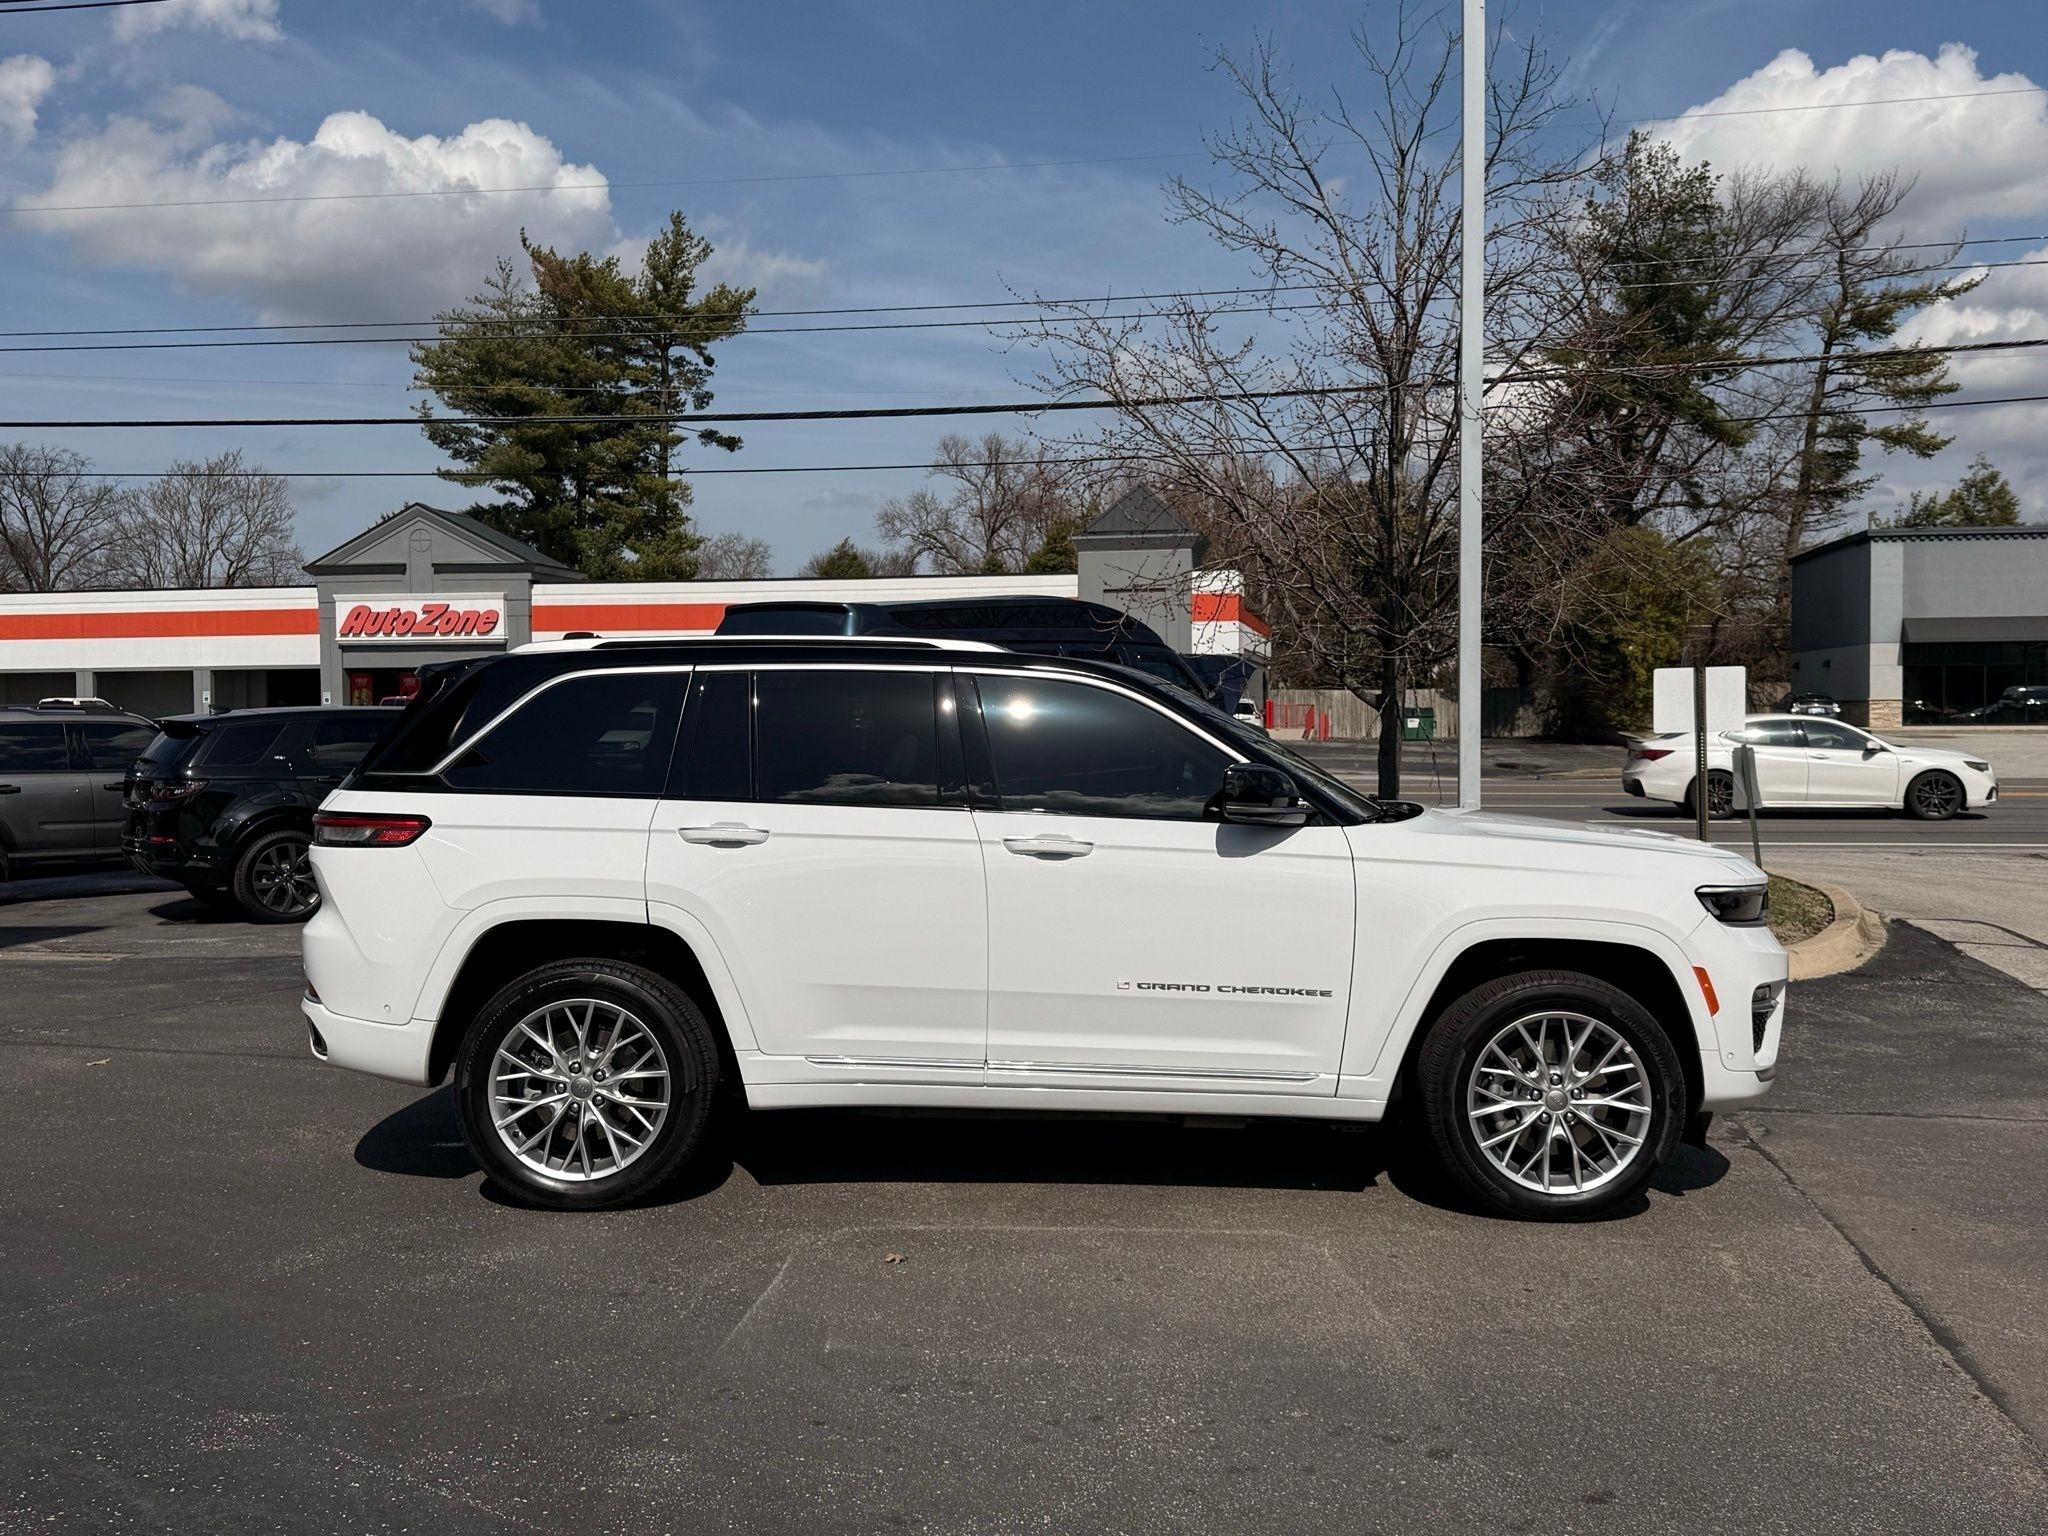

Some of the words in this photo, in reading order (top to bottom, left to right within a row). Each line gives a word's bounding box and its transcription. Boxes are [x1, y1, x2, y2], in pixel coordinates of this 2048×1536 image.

[339, 604, 500, 636] AutoZone
[1136, 982, 1211, 992] GRAND
[1217, 985, 1333, 997] CHEROKEE
